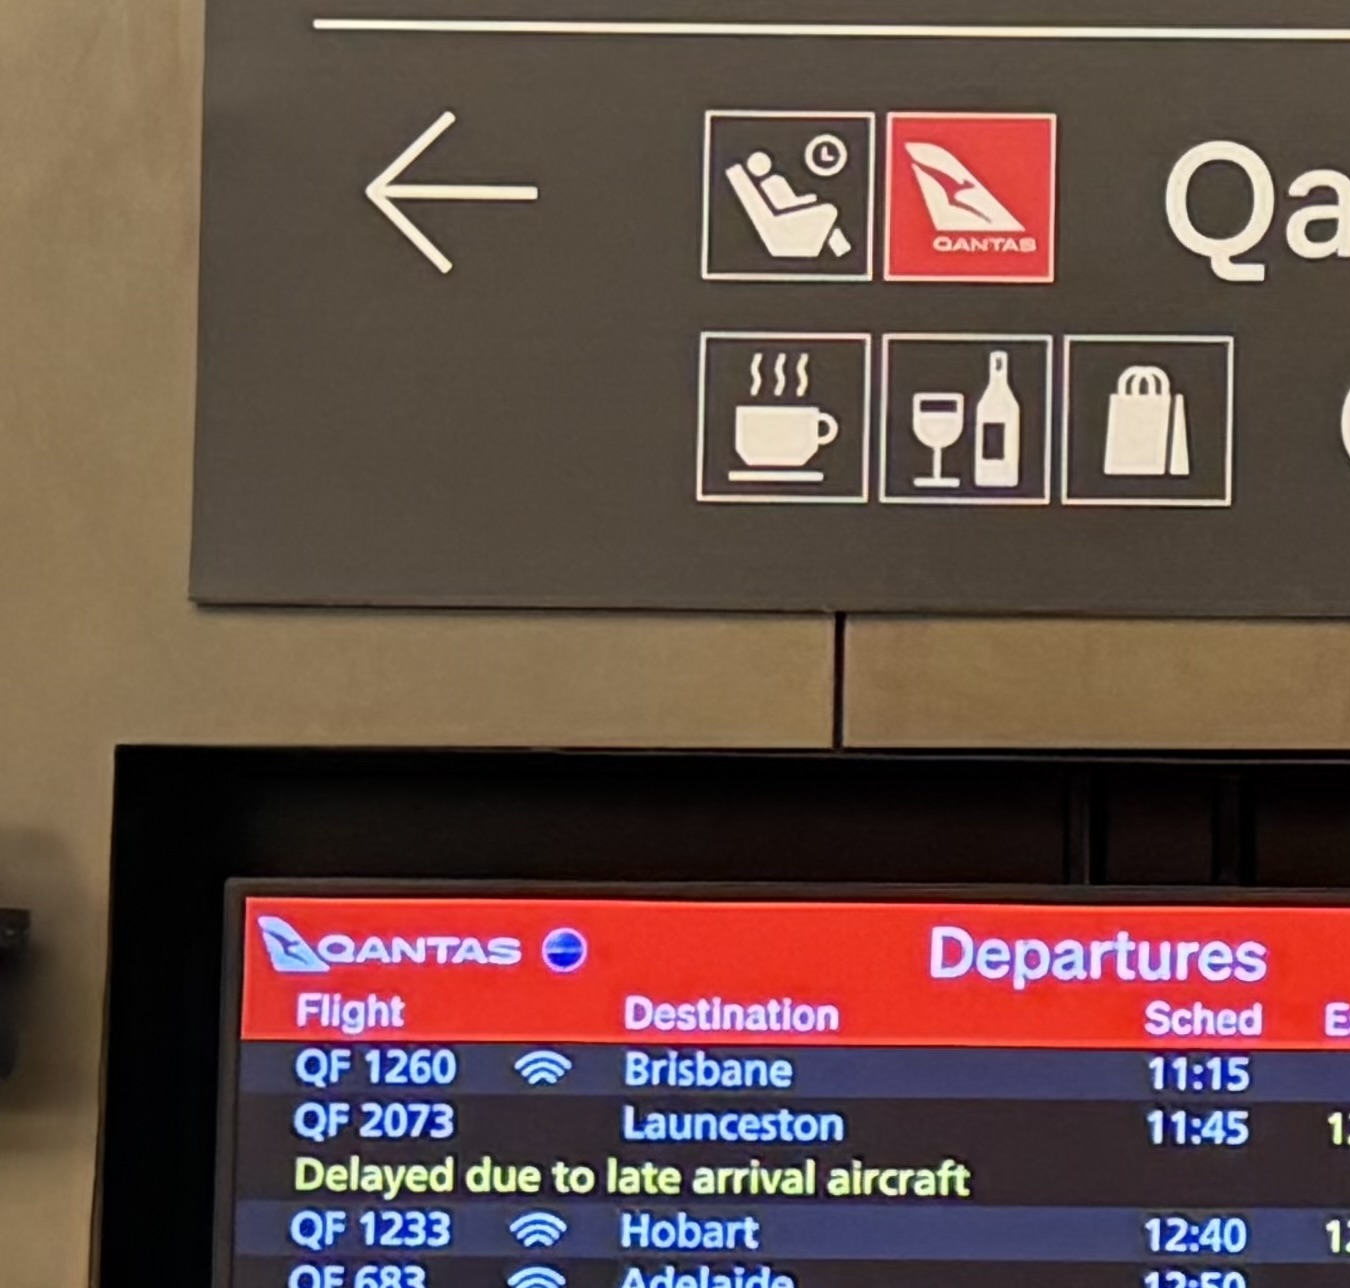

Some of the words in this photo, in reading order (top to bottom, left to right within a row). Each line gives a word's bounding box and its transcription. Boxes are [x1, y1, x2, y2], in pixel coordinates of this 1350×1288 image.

[932, 236, 1037, 253] QANTAS
[320, 935, 523, 968] QANTAS
[929, 925, 1268, 991] Departures
[296, 991, 406, 1036] Flight
[624, 994, 840, 1033] Destination
[1144, 999, 1263, 1037] Sched
[295, 1047, 352, 1089] QF
[364, 1048, 457, 1085] 1260
[624, 1049, 794, 1089] Brisbane
[1147, 1055, 1251, 1093] 11:15
[293, 1101, 351, 1143] QF
[358, 1101, 455, 1139] 2073
[623, 1104, 845, 1142] Launceston
[1146, 1109, 1250, 1146] 11:45
[294, 1154, 455, 1202] Delayed
[464, 1154, 543, 1194] due
[550, 1160, 596, 1195] to
[606, 1156, 683, 1195] late
[691, 1157, 817, 1196] arrival
[826, 1158, 972, 1198] aircraft
[289, 1209, 347, 1251] QF
[358, 1210, 451, 1248] 1233
[620, 1211, 760, 1250] Hobart
[1144, 1216, 1248, 1254] 12:40
